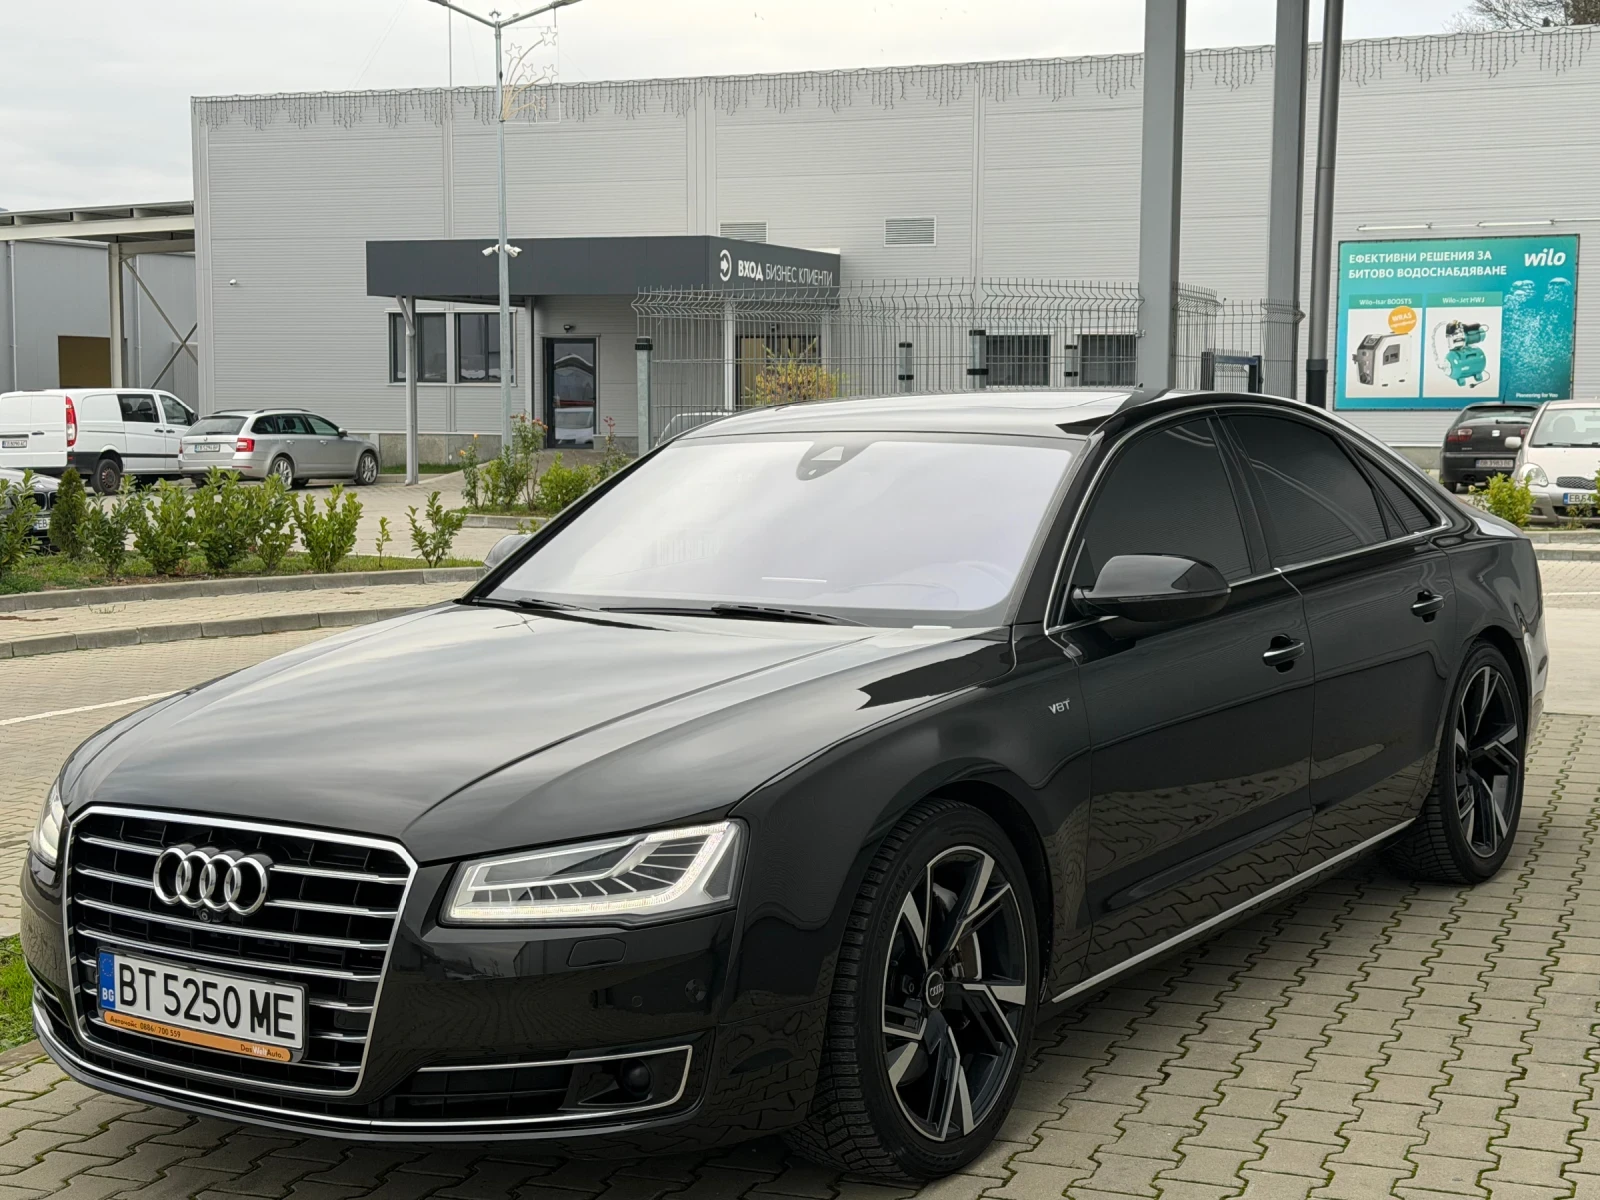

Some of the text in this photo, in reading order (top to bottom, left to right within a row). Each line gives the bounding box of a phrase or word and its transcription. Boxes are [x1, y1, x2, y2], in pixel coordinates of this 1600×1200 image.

[1349, 250, 1492, 263] ЕФЕКТИВНИ РЕШЕНИЯ ЗА
[1524, 248, 1566, 267] wilo
[738, 260, 833, 287] ВХОД БИЗНЕС КЛИЕНТИ
[1348, 265, 1507, 279] БИТОВО ВОДОСНАБДЯВАНЕ
[1569, 495, 1580, 503] EB
[1048, 699, 1071, 715] V8T
[878, 864, 913, 939] YOKOHAMA
[102, 963, 296, 1040] BG BT 5250 ME
[139, 1022, 156, 1033] 0886/
[158, 1026, 169, 1036] 700
[170, 1029, 181, 1038] 559
